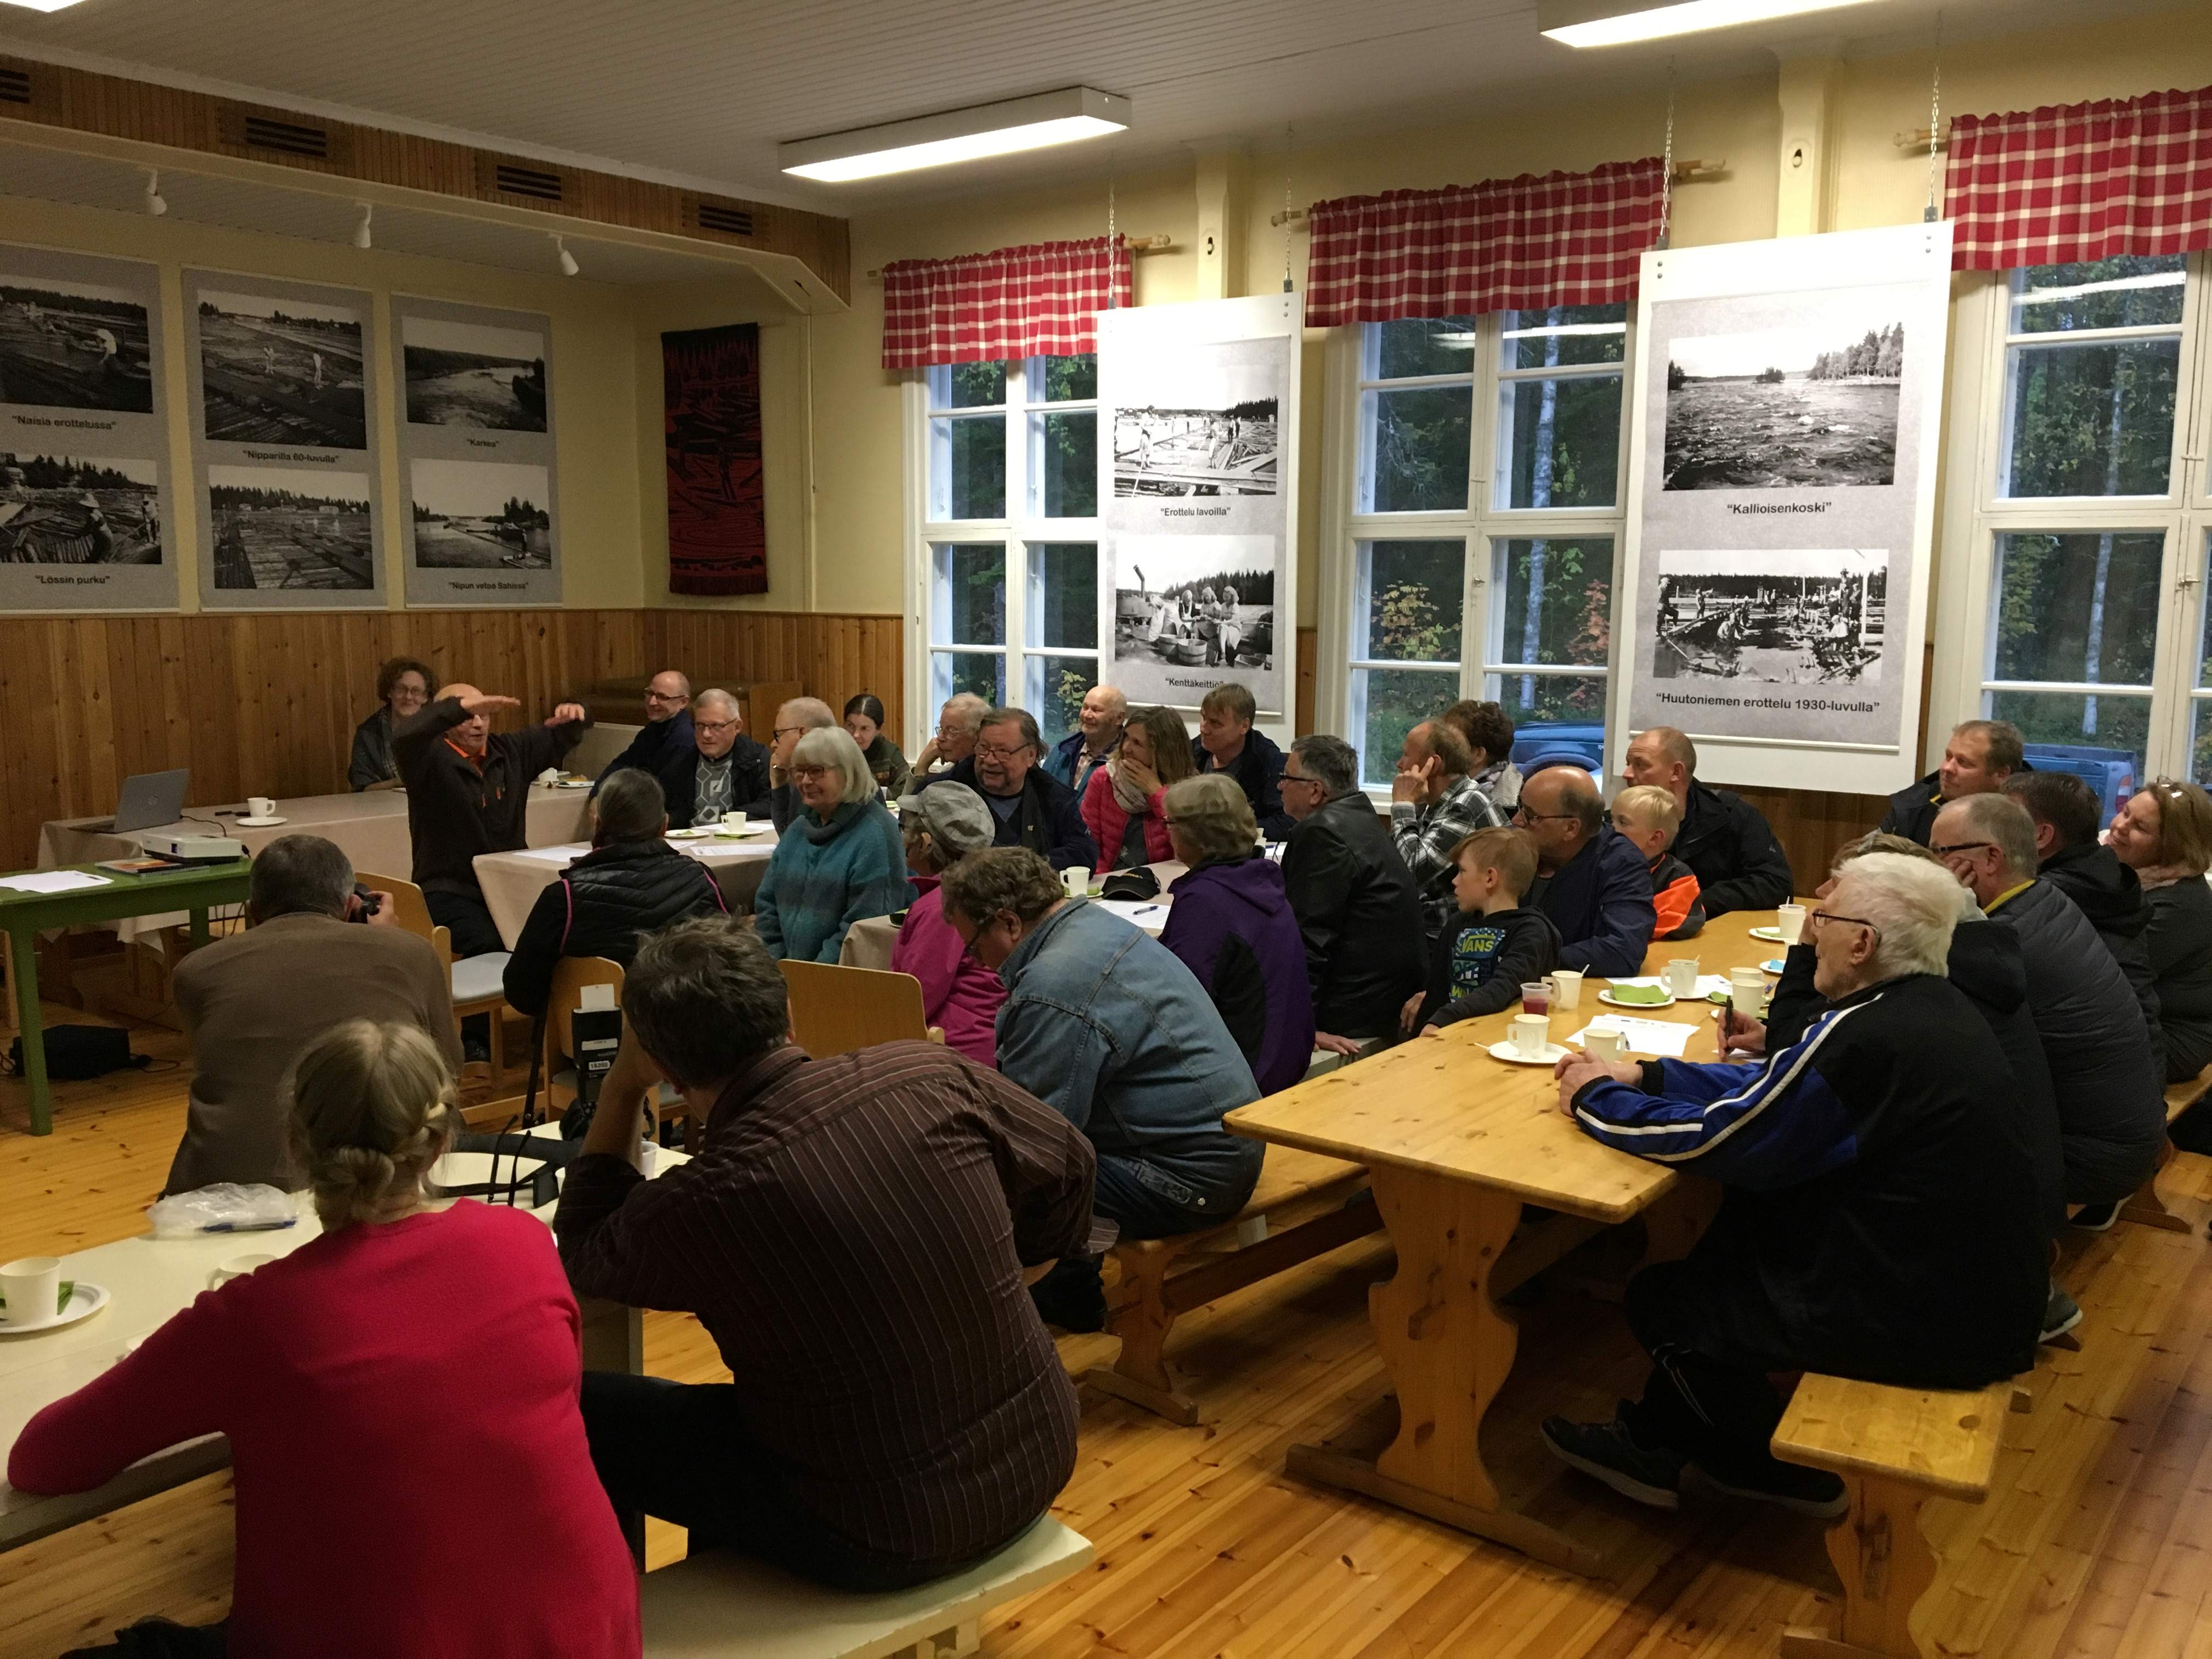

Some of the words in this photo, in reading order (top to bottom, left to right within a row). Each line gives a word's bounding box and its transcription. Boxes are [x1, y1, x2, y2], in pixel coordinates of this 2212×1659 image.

[12, 415, 51, 426] “Naisia
[1160, 507, 1195, 516] “Erottelu
[1197, 507, 1231, 516] lavoilla”
[1727, 501, 1832, 514] “Kallioisenkoski”
[77, 575, 110, 585] purku”
[1656, 692, 1740, 707] “Huutoniemen
[1743, 697, 1791, 709] erottelu
[1795, 699, 1880, 712] 1930-luvulla”
[1460, 934, 1496, 953] VANS
